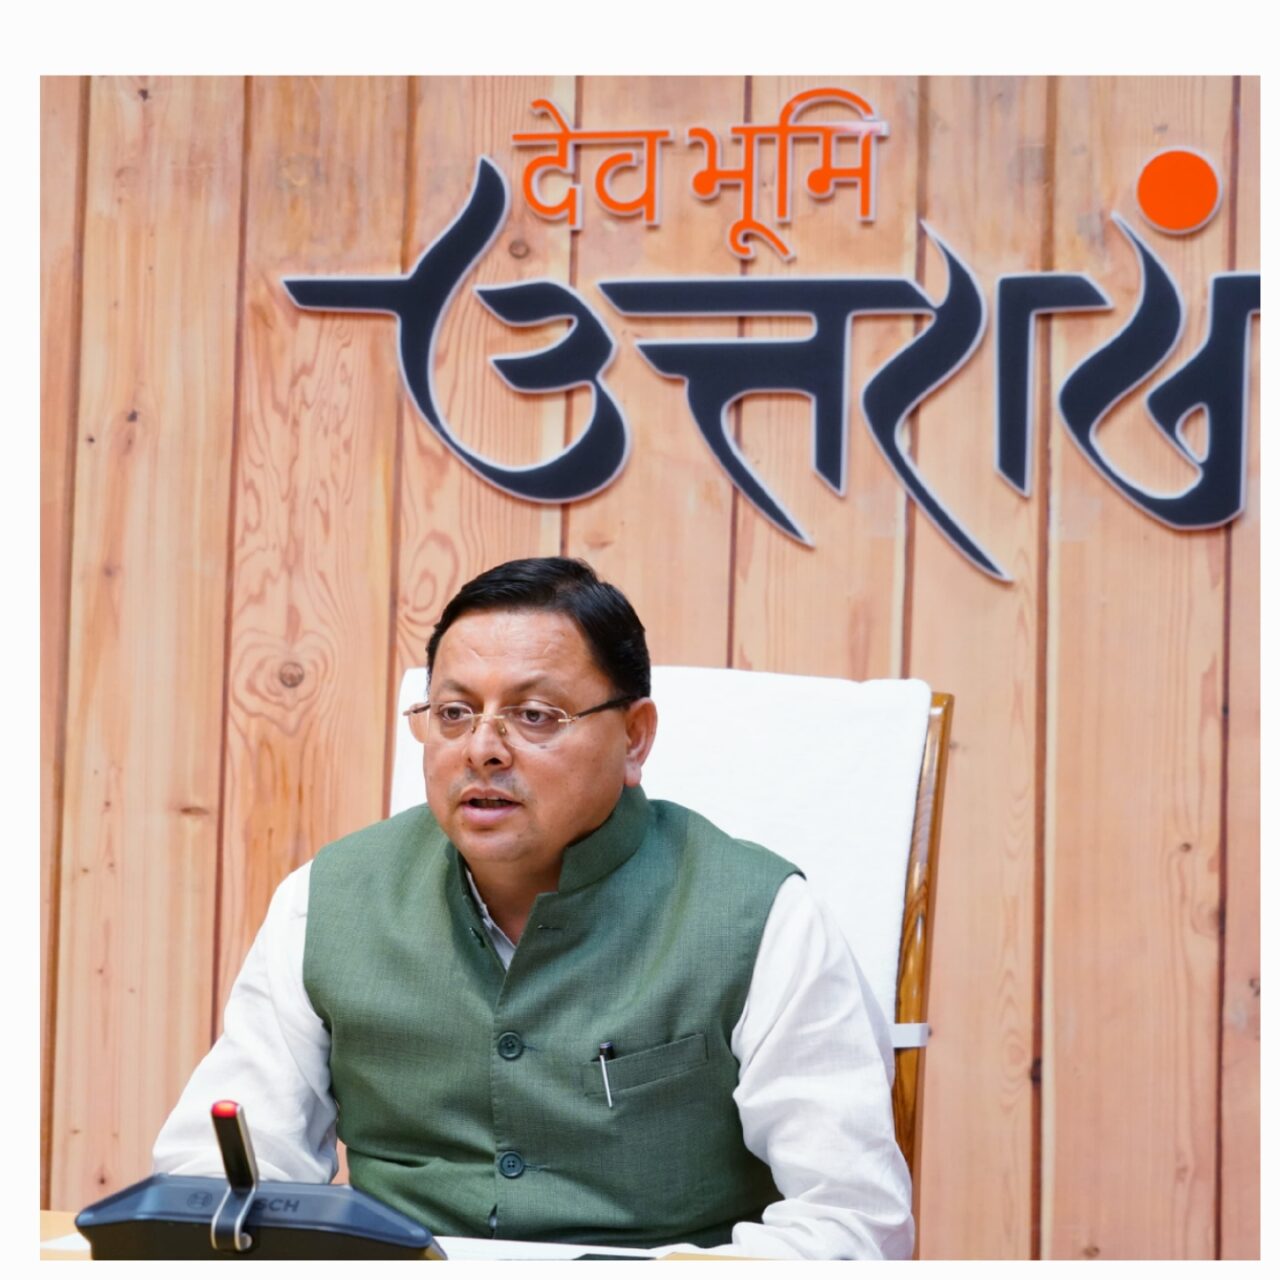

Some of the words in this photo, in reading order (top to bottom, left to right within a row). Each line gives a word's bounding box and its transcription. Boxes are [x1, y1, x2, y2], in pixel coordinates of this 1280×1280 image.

[513, 98, 673, 230] देव
[687, 88, 887, 260] भूमि
[281, 148, 1260, 582] उत्तराखं
[252, 1197, 300, 1213] SCH
